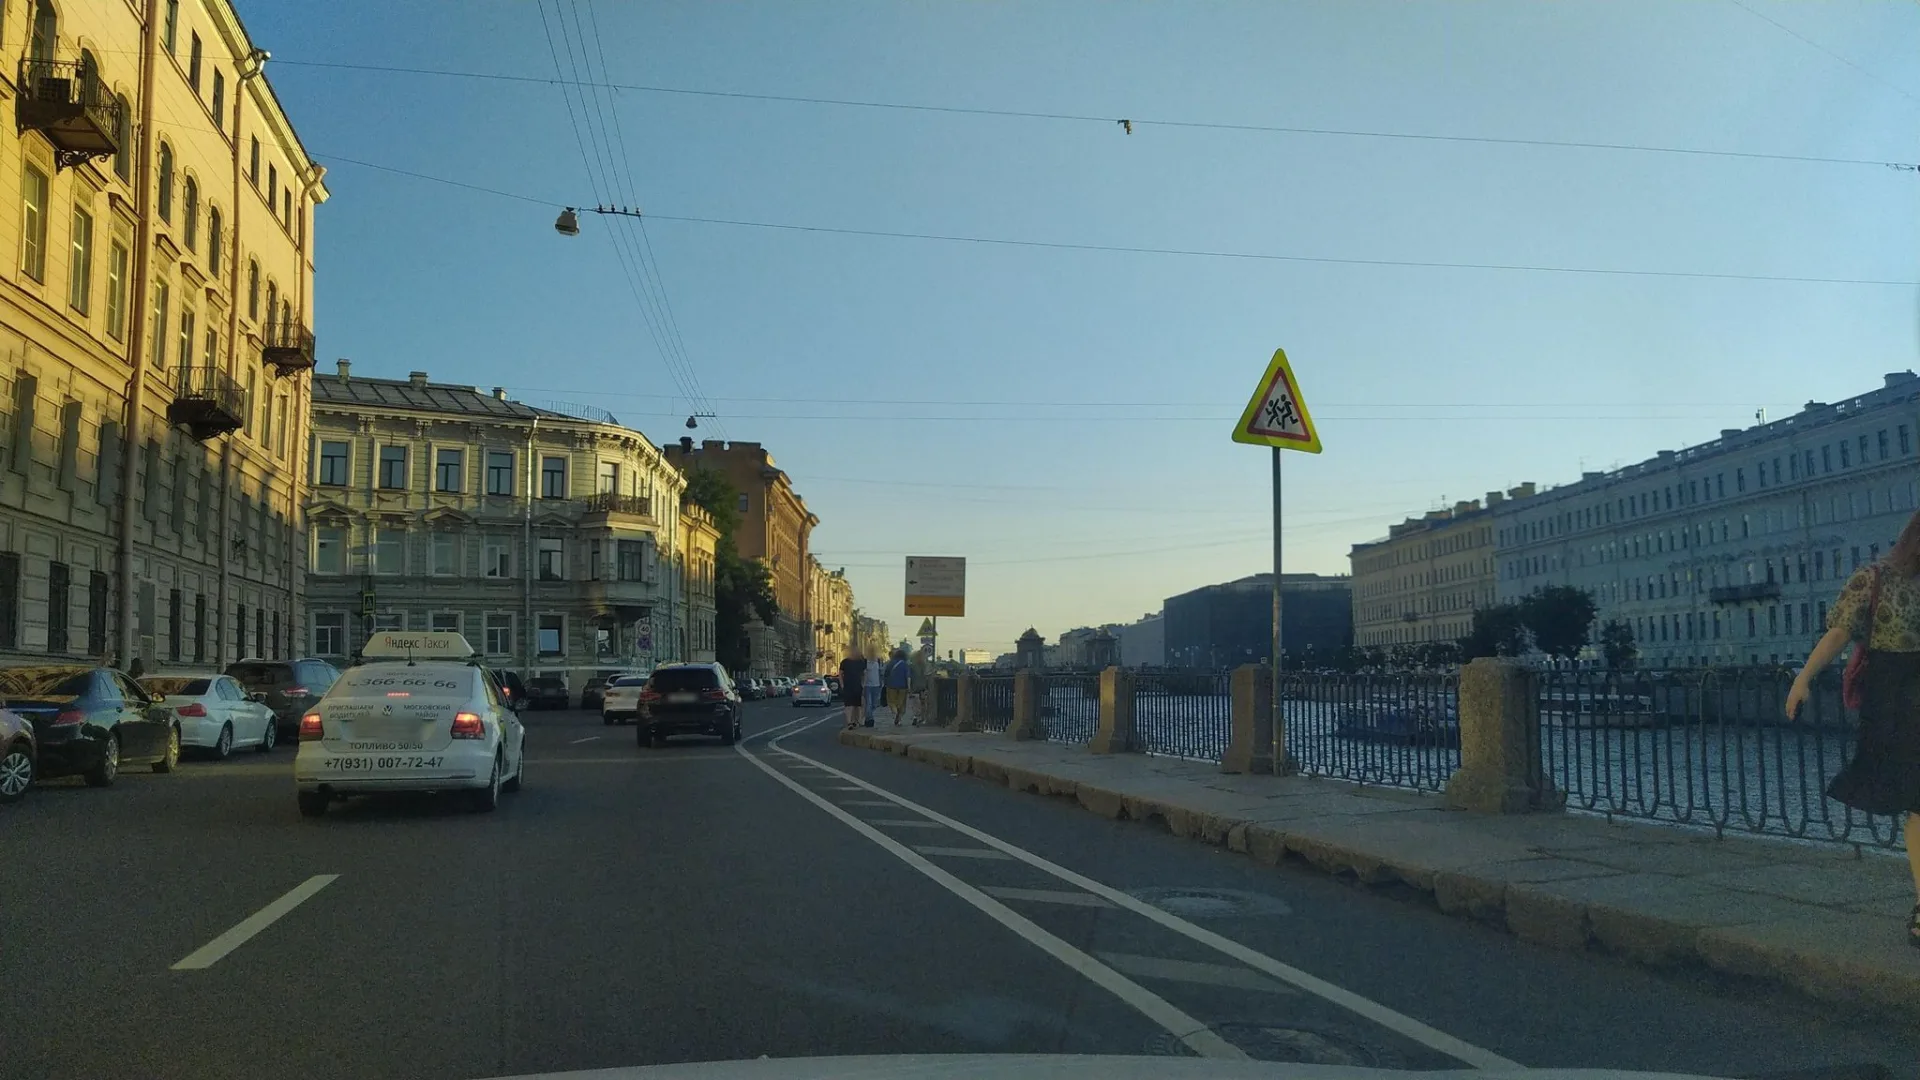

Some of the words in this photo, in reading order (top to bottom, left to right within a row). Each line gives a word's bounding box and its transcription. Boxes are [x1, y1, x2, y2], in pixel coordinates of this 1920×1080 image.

[384, 636, 420, 649] Яндекс
[422, 637, 449, 649] Такси
[359, 678, 458, 689] 366-66-66
[350, 742, 396, 750] ТОПЛИВО
[324, 758, 373, 771] +7(931)
[378, 757, 444, 768] 007-72-47
